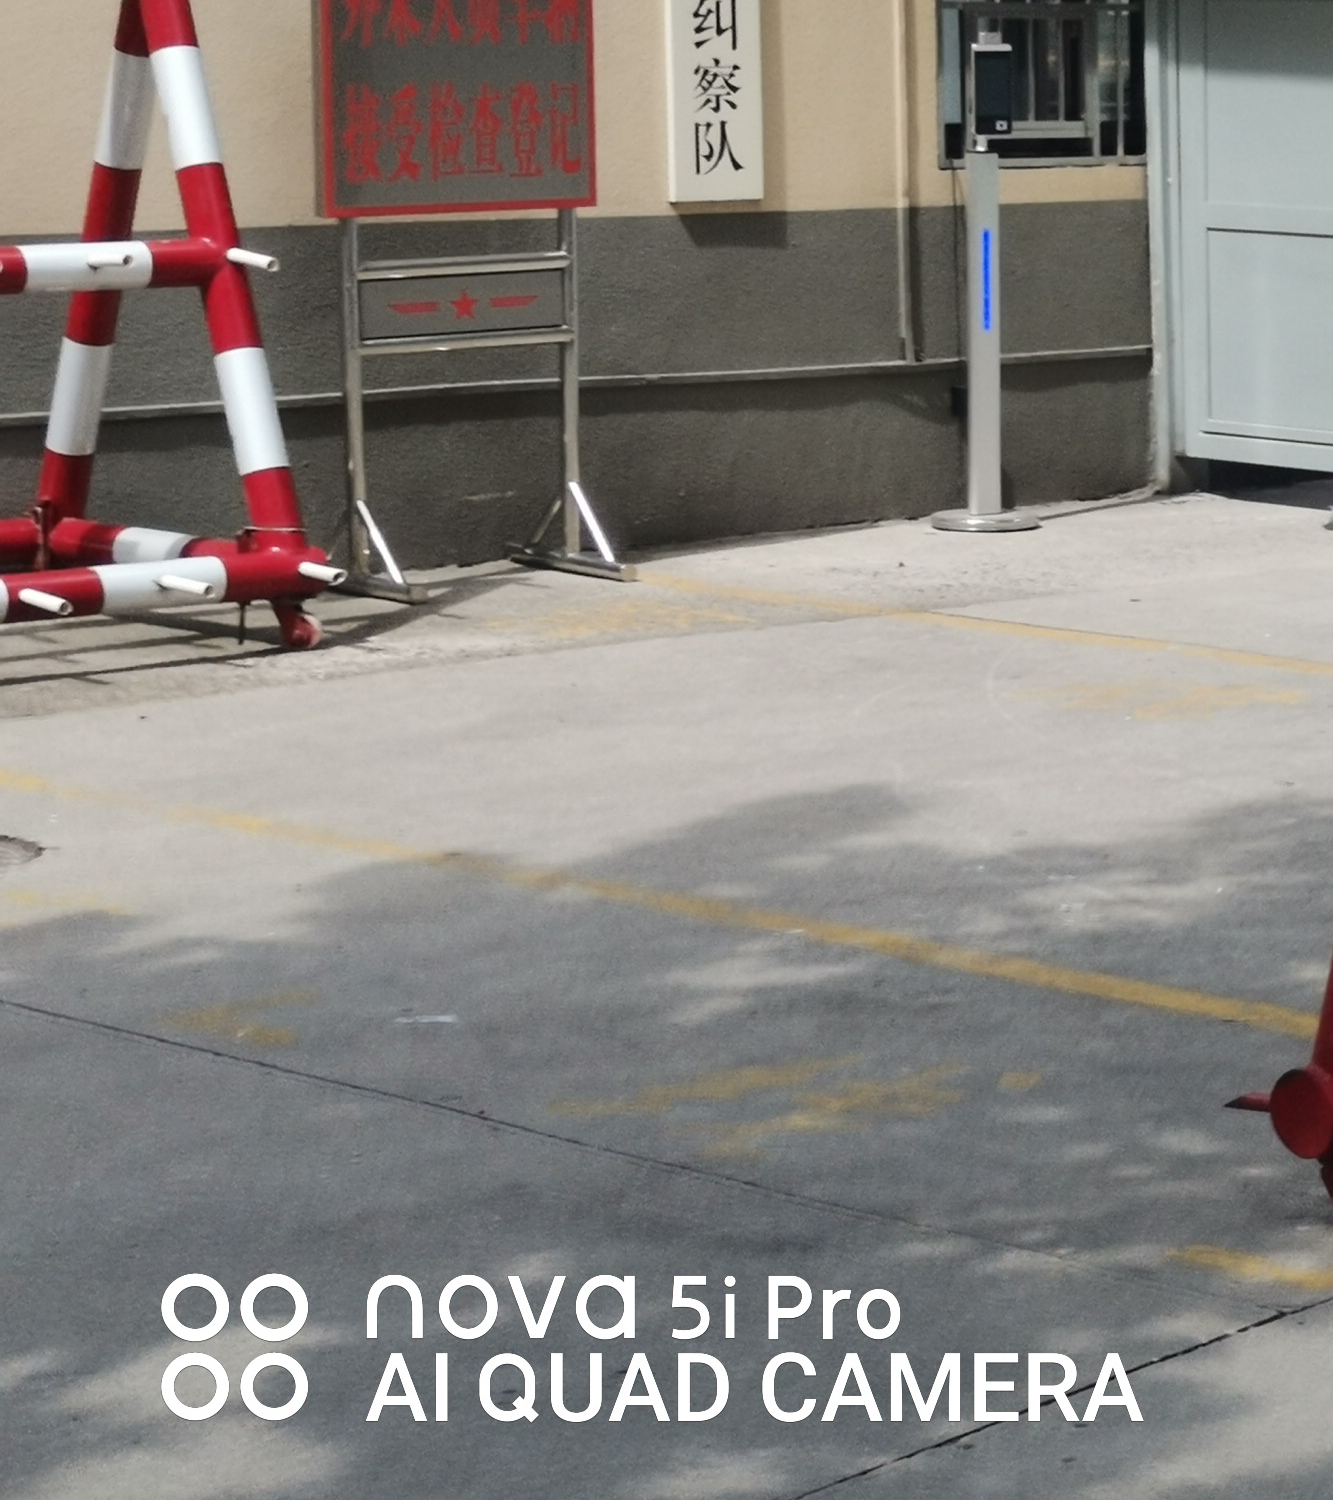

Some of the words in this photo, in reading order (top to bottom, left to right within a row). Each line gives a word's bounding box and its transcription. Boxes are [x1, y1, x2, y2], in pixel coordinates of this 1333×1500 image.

[342, 82, 582, 182] 接受检查登记
